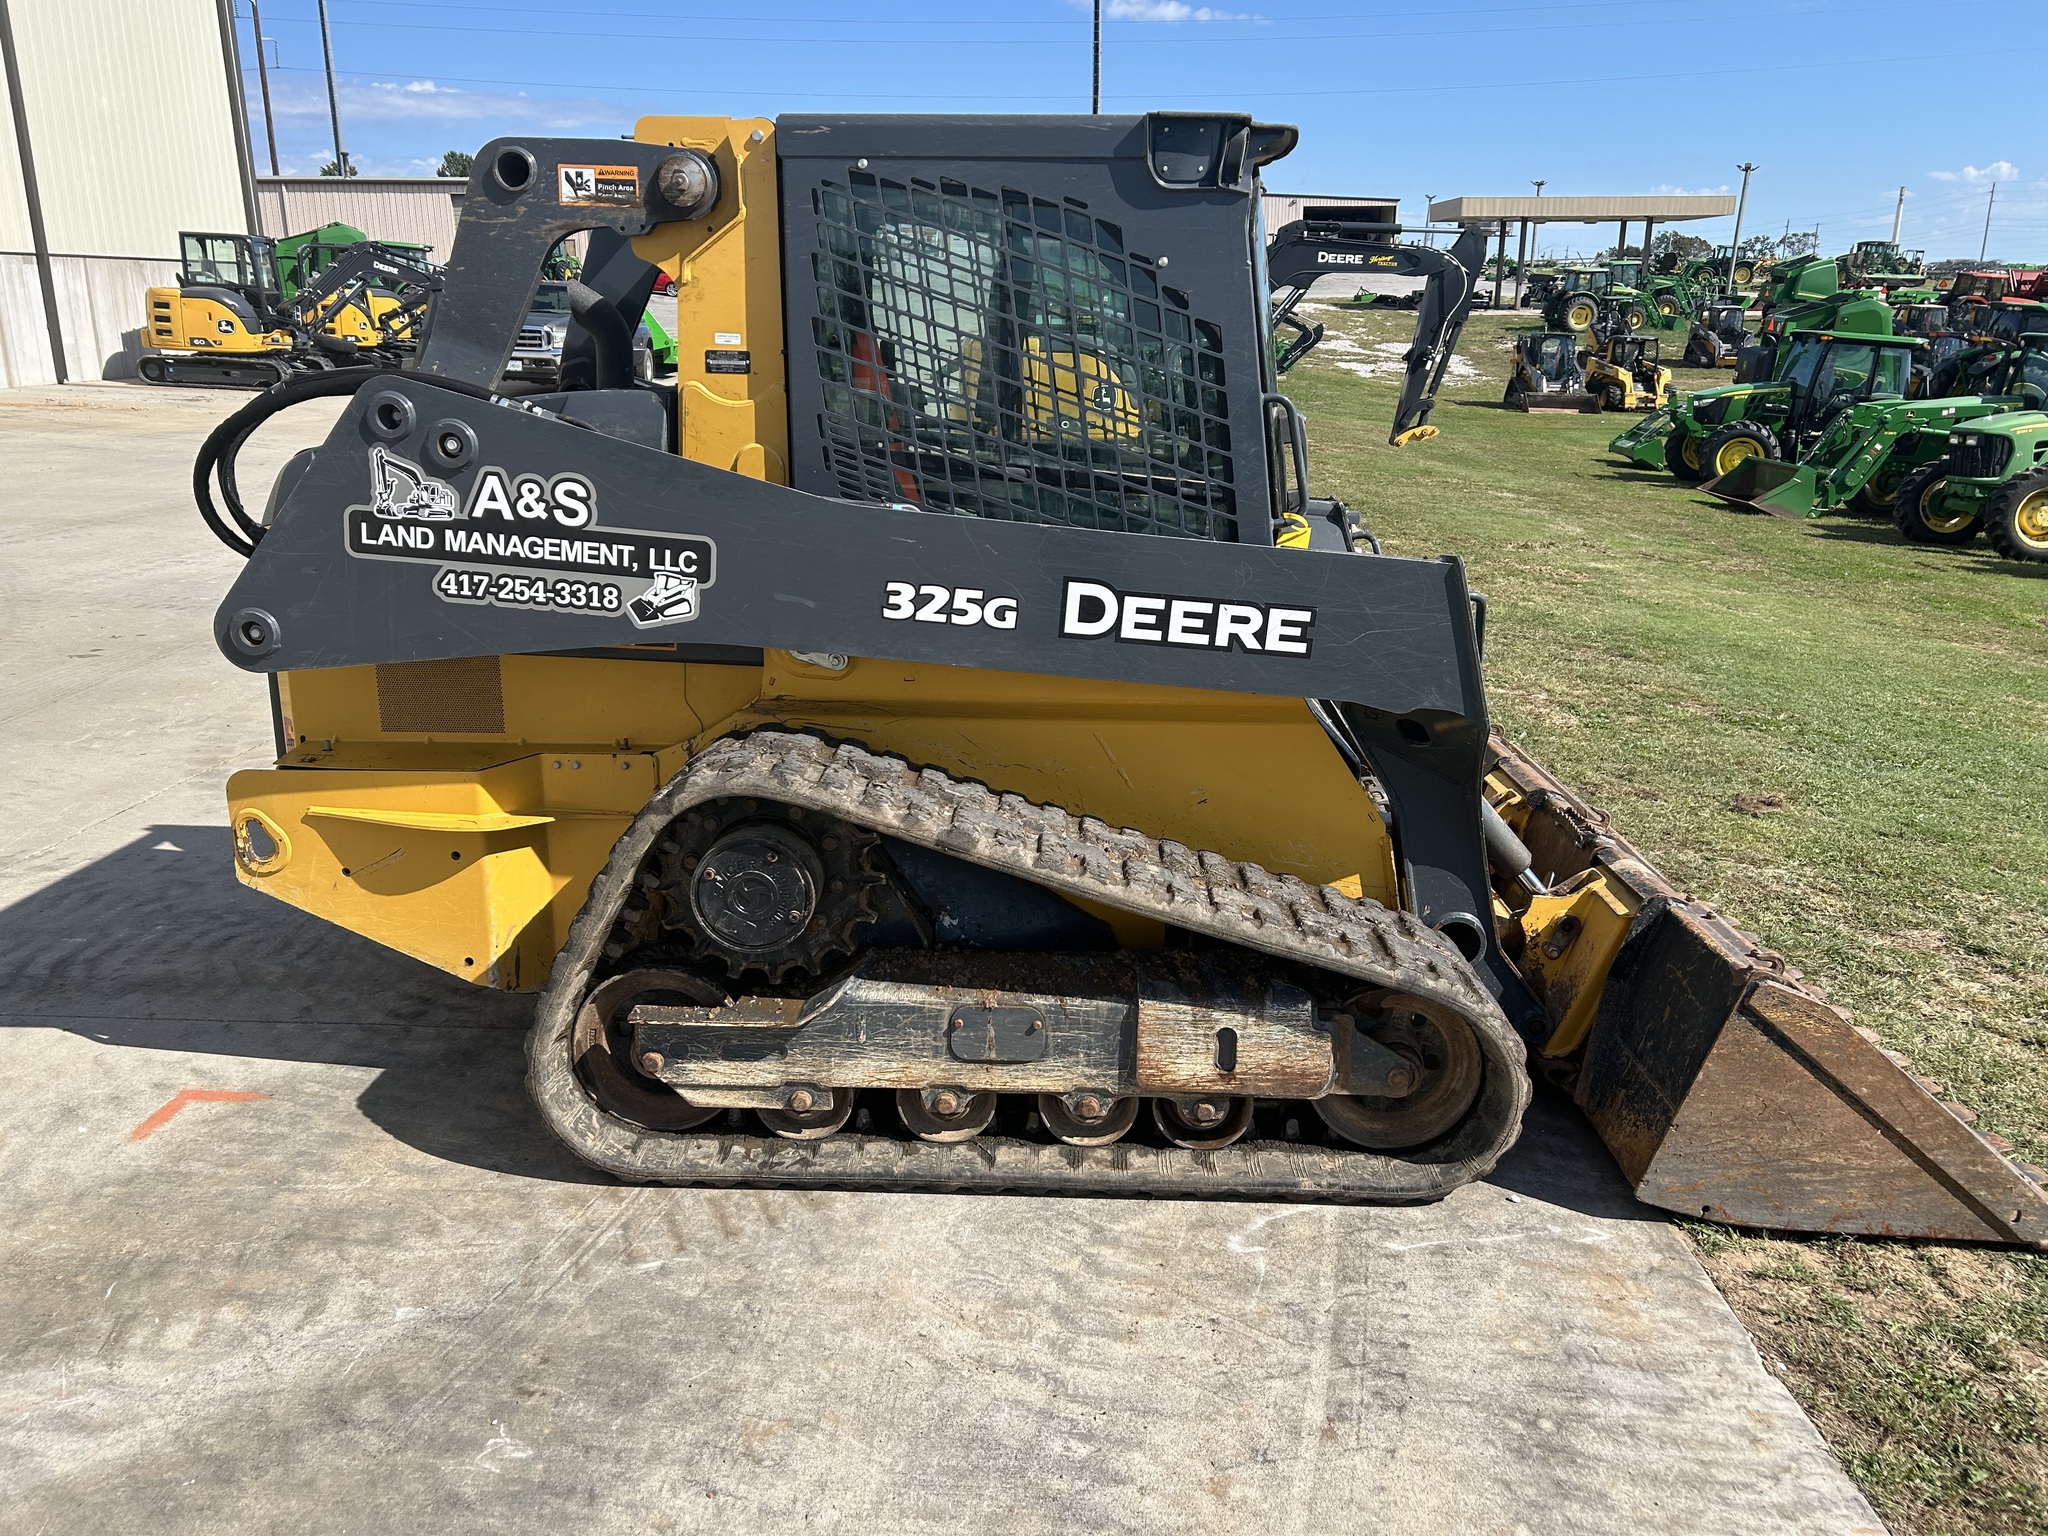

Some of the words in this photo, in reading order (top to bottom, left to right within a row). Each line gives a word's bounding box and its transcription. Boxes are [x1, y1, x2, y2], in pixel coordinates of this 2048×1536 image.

[604, 169, 635, 177] WARNING
[597, 183, 617, 191] Pinch
[618, 183, 634, 192] Area
[372, 260, 399, 275] DEERE
[1317, 251, 1364, 265] DEERE
[472, 474, 589, 528] A&S
[360, 522, 435, 550] LAND
[444, 528, 640, 573] MANAGEMENT,
[648, 547, 698, 573] LLC
[441, 572, 620, 608] 417-254-3318
[882, 581, 1019, 630] 325G
[1062, 580, 1313, 656] DEERE
